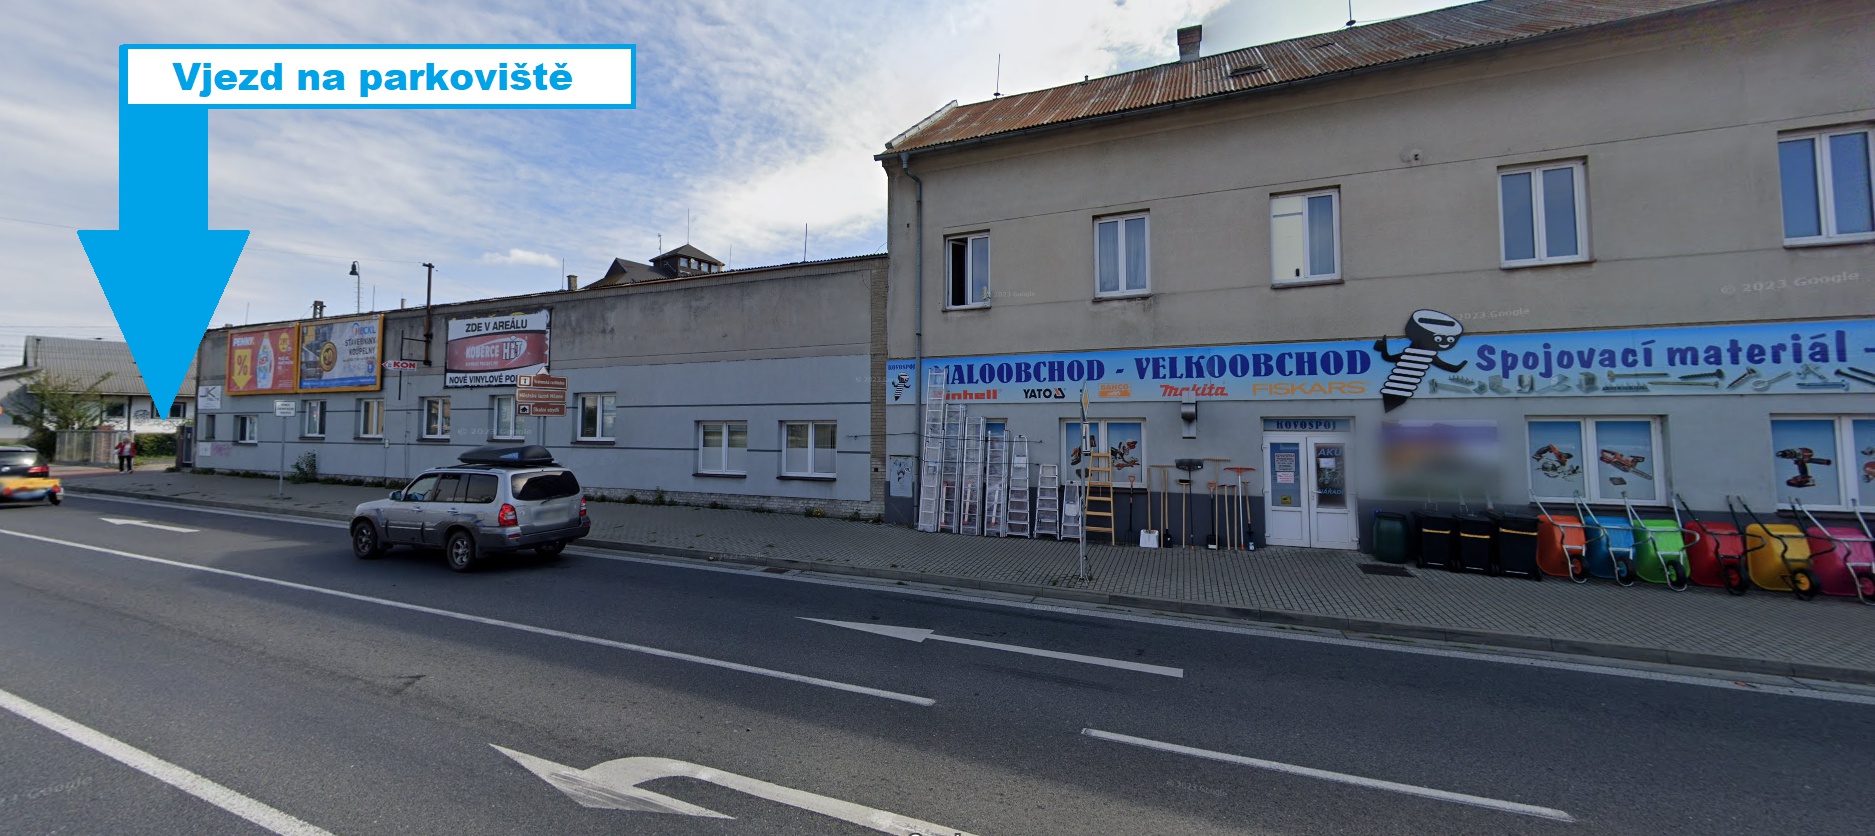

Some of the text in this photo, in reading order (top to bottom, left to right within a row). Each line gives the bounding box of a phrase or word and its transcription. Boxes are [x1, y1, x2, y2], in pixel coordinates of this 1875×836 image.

[465, 318, 528, 333] ZDE V AREÁLU
[465, 345, 500, 359] KOBERCE
[1476, 340, 1656, 379] Spojovací
[1667, 329, 1848, 367] materiál
[393, 361, 416, 369] KON
[1134, 349, 1371, 380] VELKOOBCHOD
[449, 374, 468, 385] NOVÉ
[469, 373, 504, 385] VINYLOVÉ
[1023, 388, 1052, 399] YATO
[1252, 380, 1367, 397] FISKARS
[1276, 420, 1337, 431] KOVOSPOJ
[1318, 448, 1343, 457] AKU
